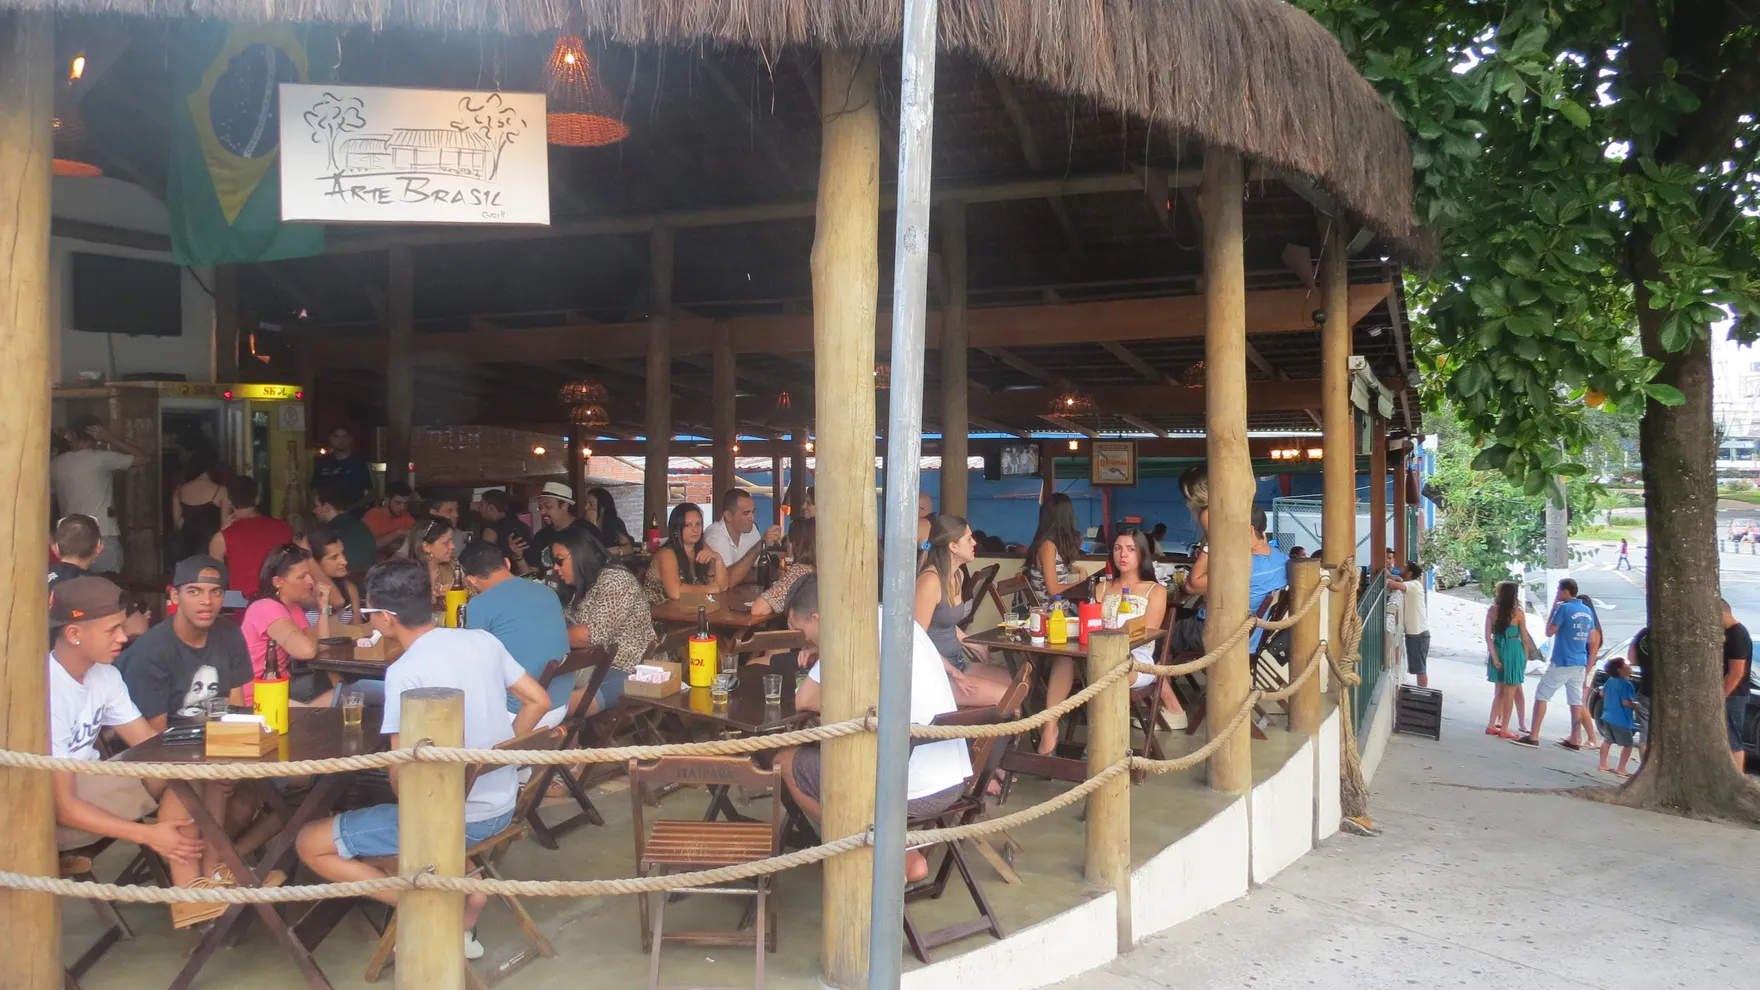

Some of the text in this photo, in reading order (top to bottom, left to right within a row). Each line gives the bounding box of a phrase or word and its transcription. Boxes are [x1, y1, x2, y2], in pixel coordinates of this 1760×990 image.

[324, 170, 504, 207] ARTE BRASIL
[263, 386, 288, 396] SKOL
